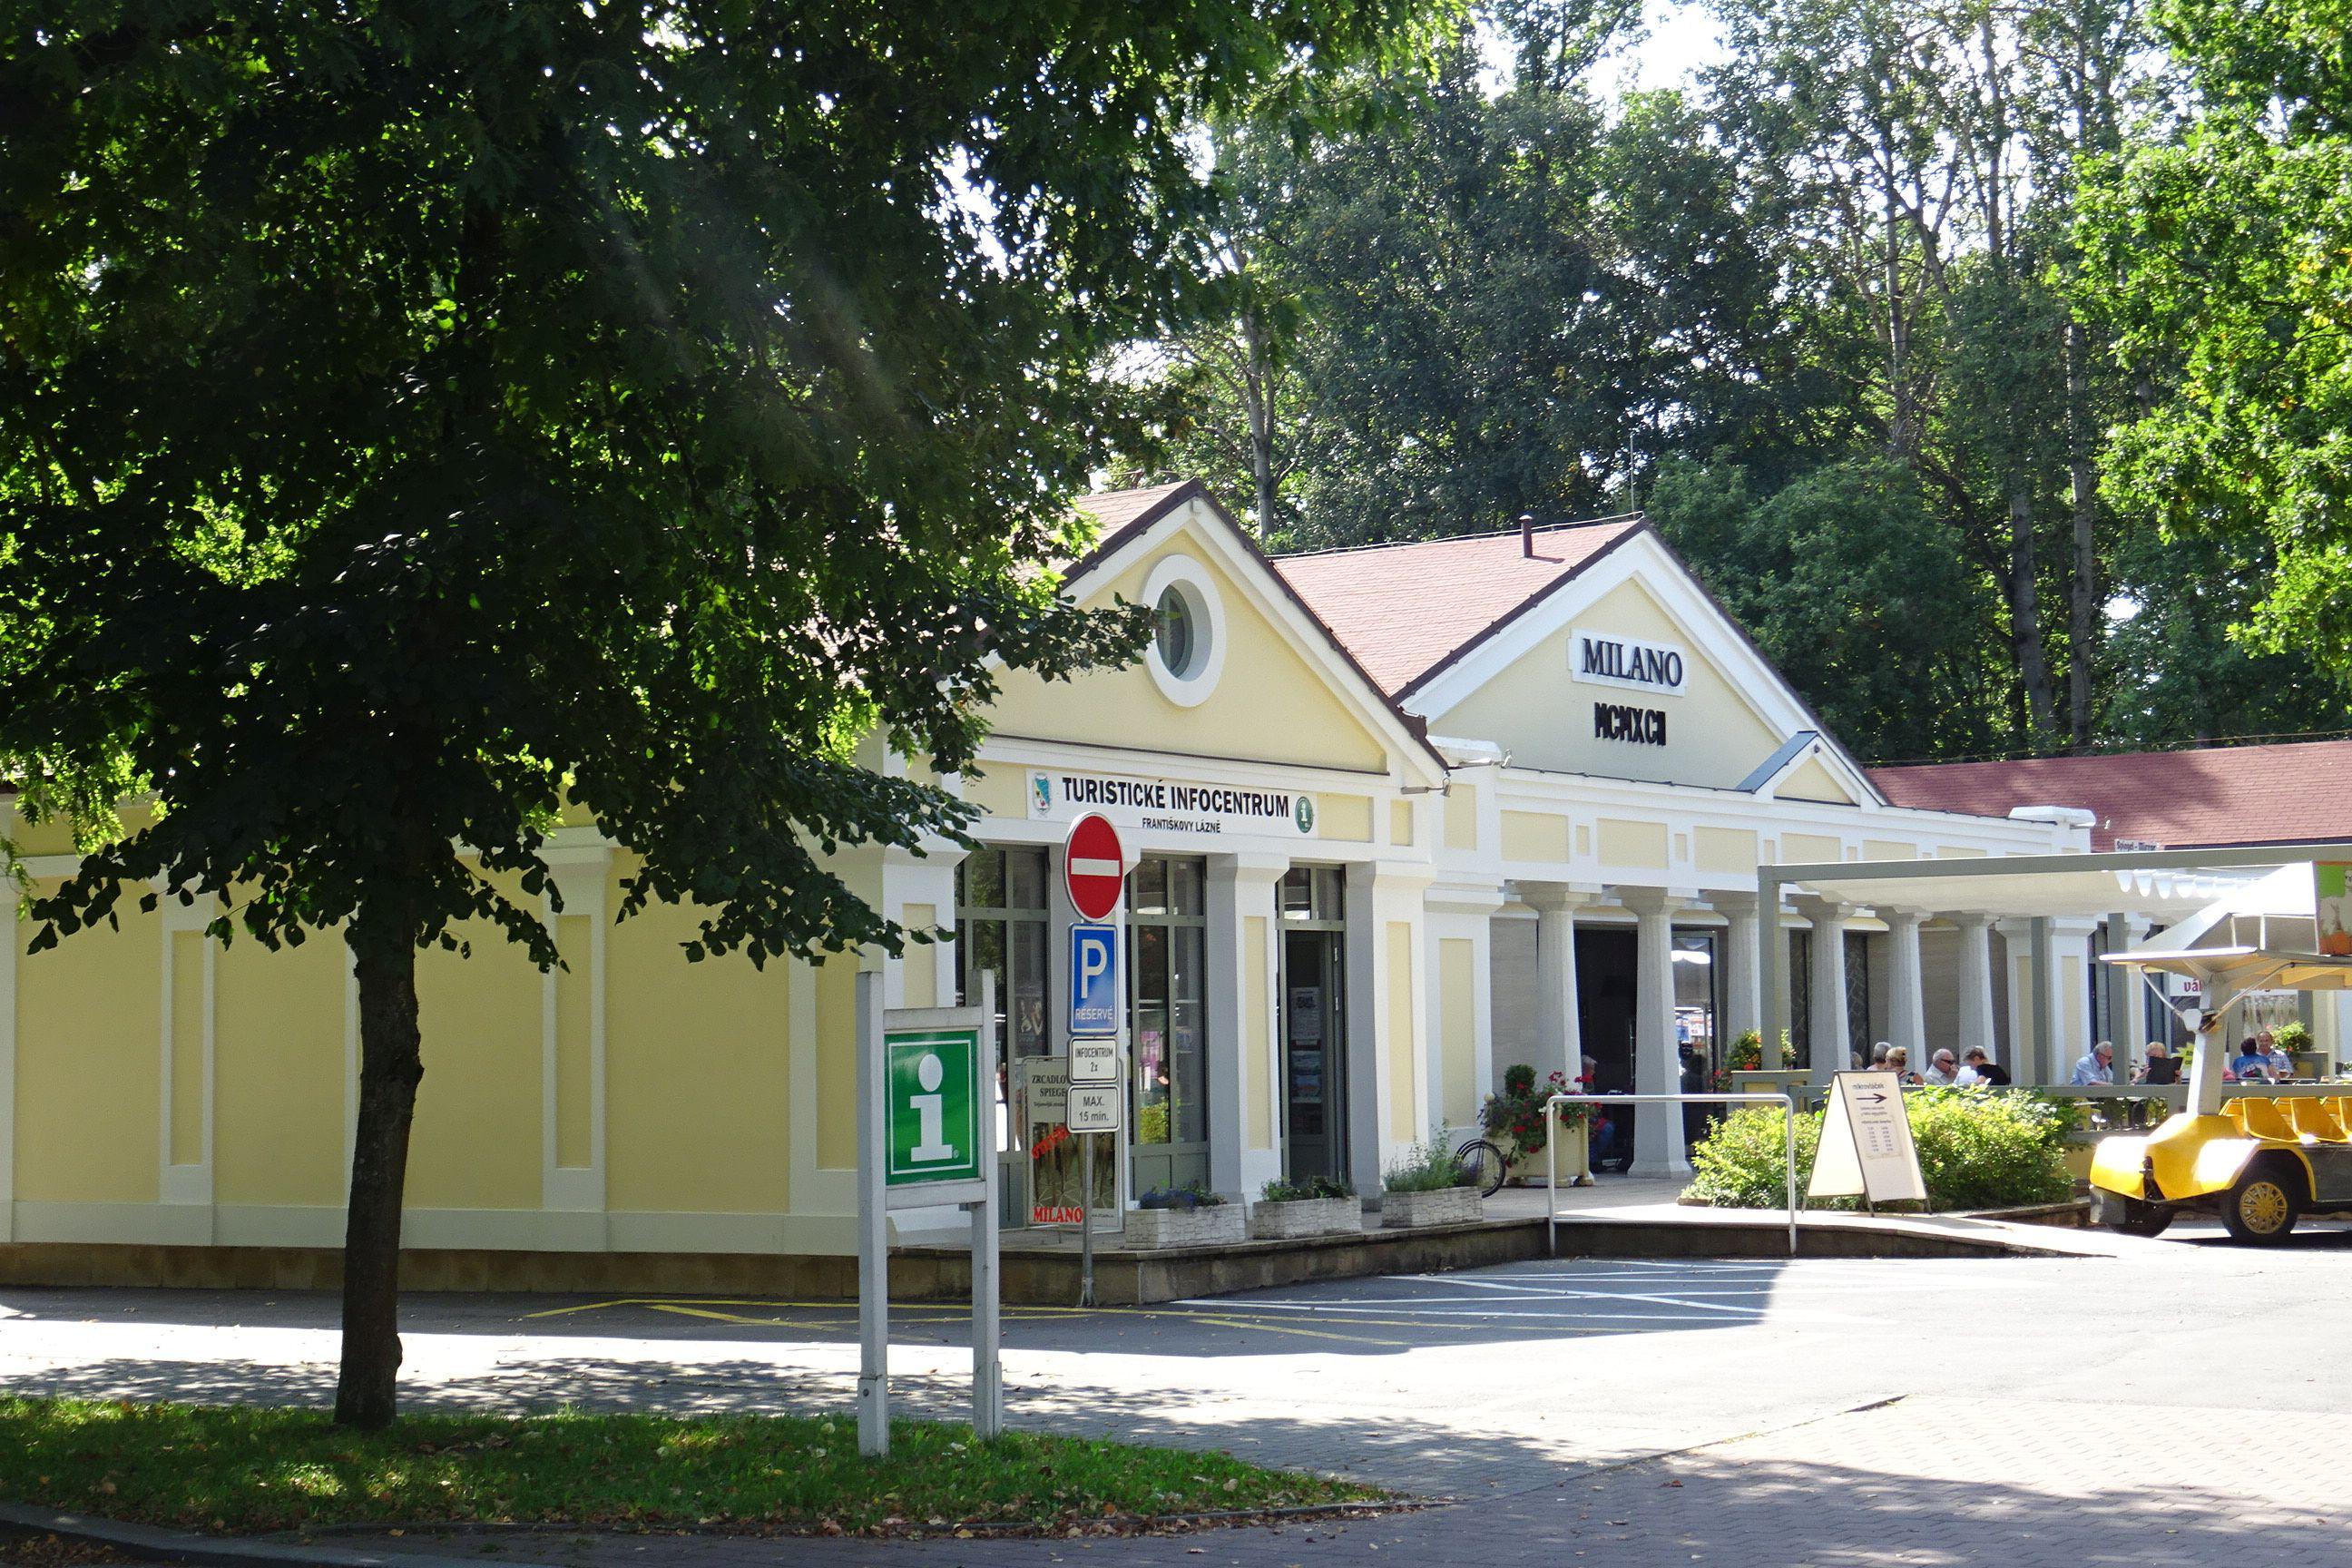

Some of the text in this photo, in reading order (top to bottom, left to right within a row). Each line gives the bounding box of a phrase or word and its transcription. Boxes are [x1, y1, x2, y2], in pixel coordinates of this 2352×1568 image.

[1583, 638, 1682, 687] MILANO
[1063, 777, 1289, 818] TURISTICKÉ INFOCENTRUM
[1142, 817, 1221, 834] FRANTIŠKOVY LÁZNĚ
[1081, 939, 1107, 999] P
[1075, 1005, 1113, 1020] RÉSERVÉ
[1074, 1047, 1113, 1059] INFOCENTRUM
[1032, 1074, 1068, 1083] ZRCADLO
[1083, 1096, 1105, 1107] MAX.
[1079, 1111, 1110, 1122] 15 min.
[1033, 1205, 1083, 1223] MILANO
